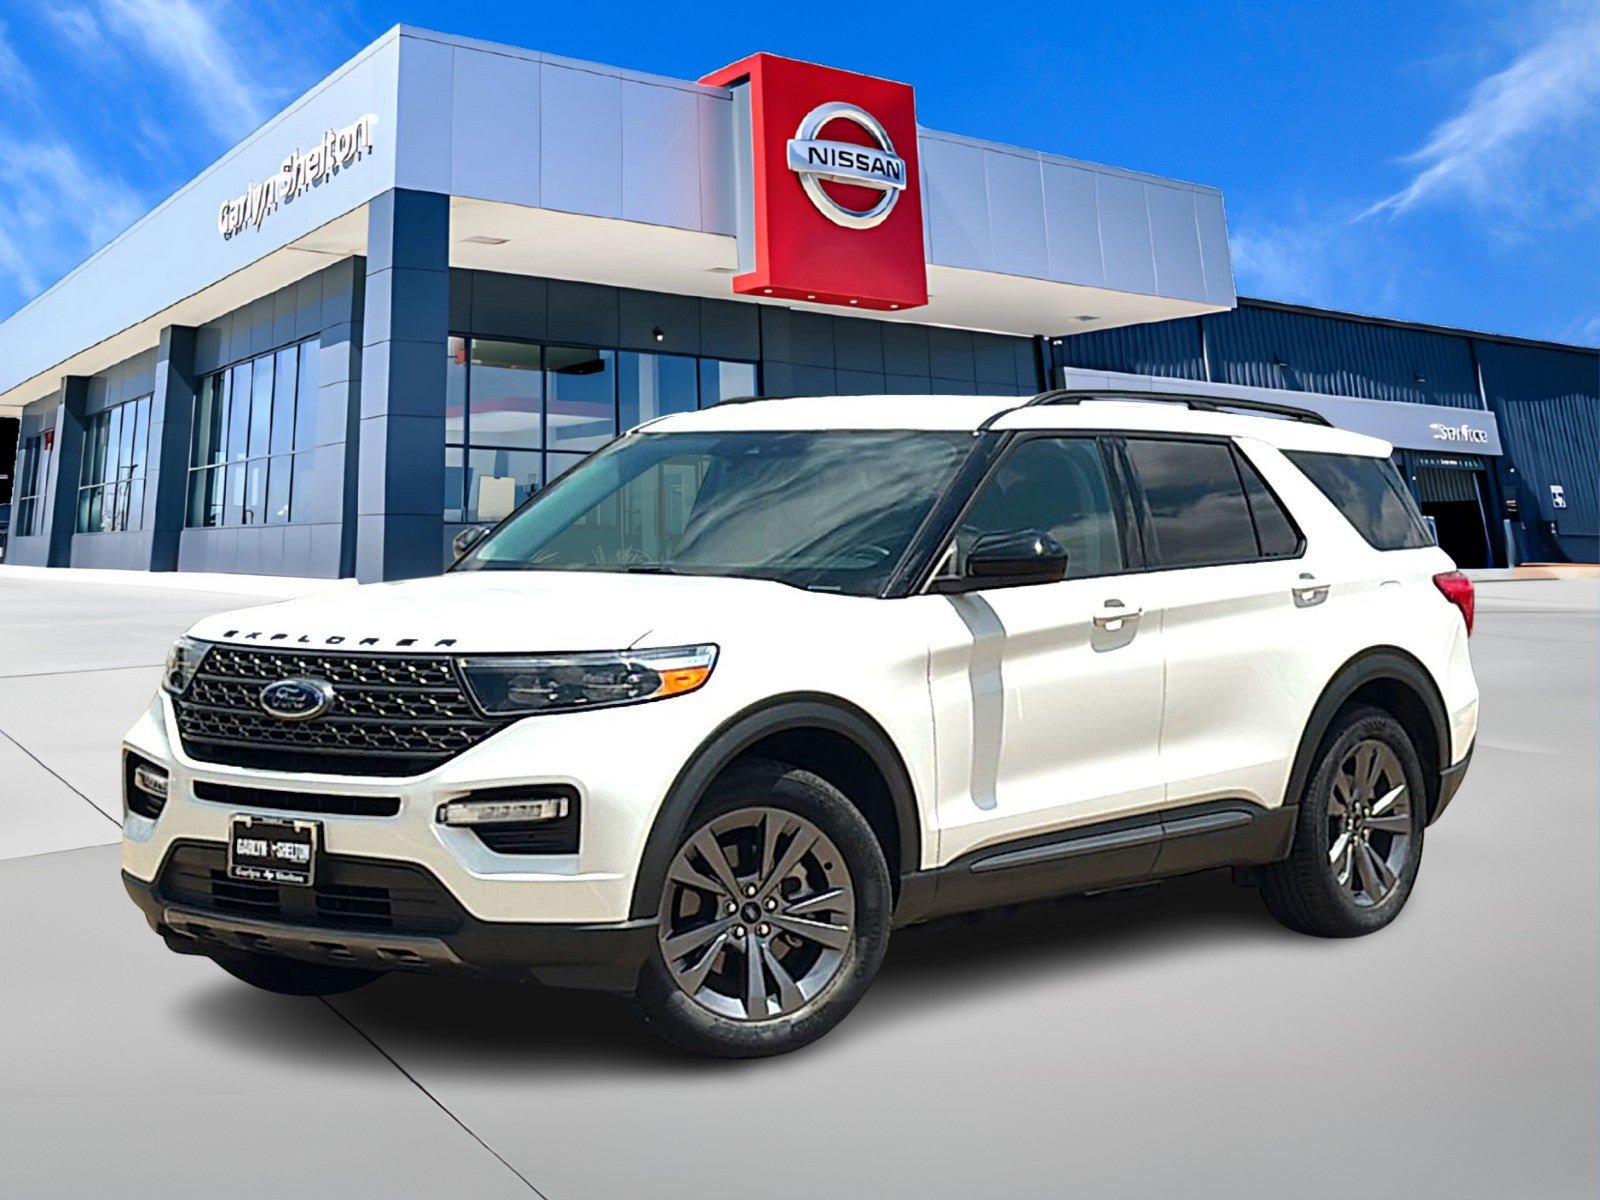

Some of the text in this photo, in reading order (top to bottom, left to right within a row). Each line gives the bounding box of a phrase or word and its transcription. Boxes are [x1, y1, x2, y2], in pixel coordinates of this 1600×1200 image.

[282, 113, 379, 204] Shelton
[808, 146, 900, 180] NISSAN
[223, 630, 457, 646] EXPLORER
